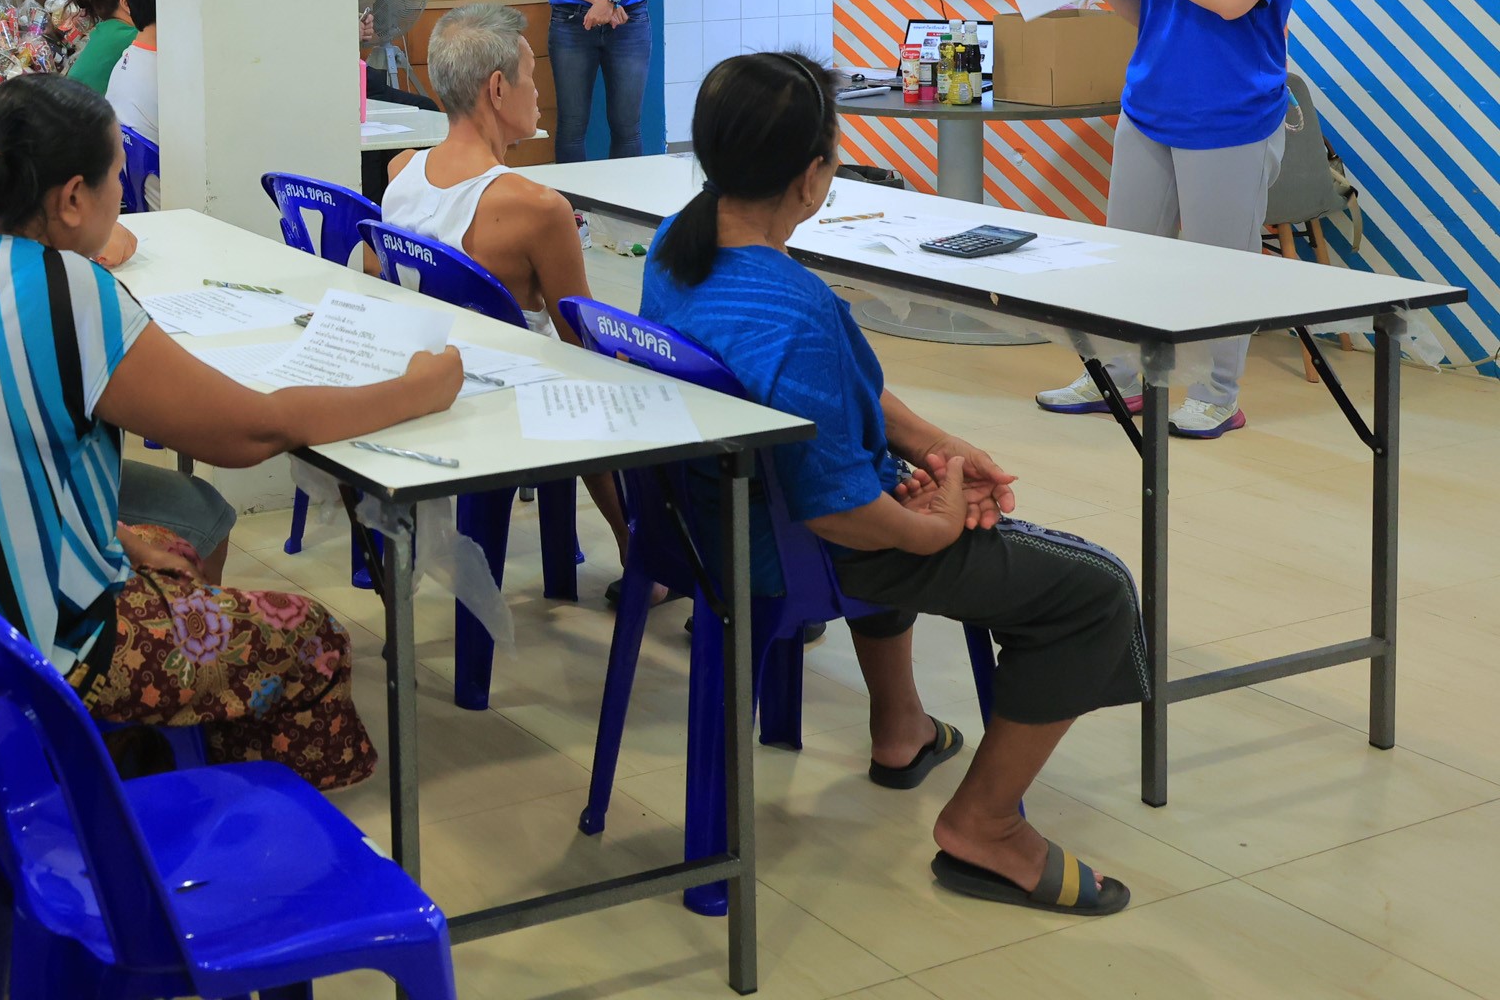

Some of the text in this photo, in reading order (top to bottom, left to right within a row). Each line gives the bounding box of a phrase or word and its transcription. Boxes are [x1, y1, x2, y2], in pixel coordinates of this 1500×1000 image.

[285, 183, 336, 207] สนง.ขคล.
[382, 233, 437, 266] สนง.ขคล.
[597, 315, 677, 362] สนง.ขคล.
